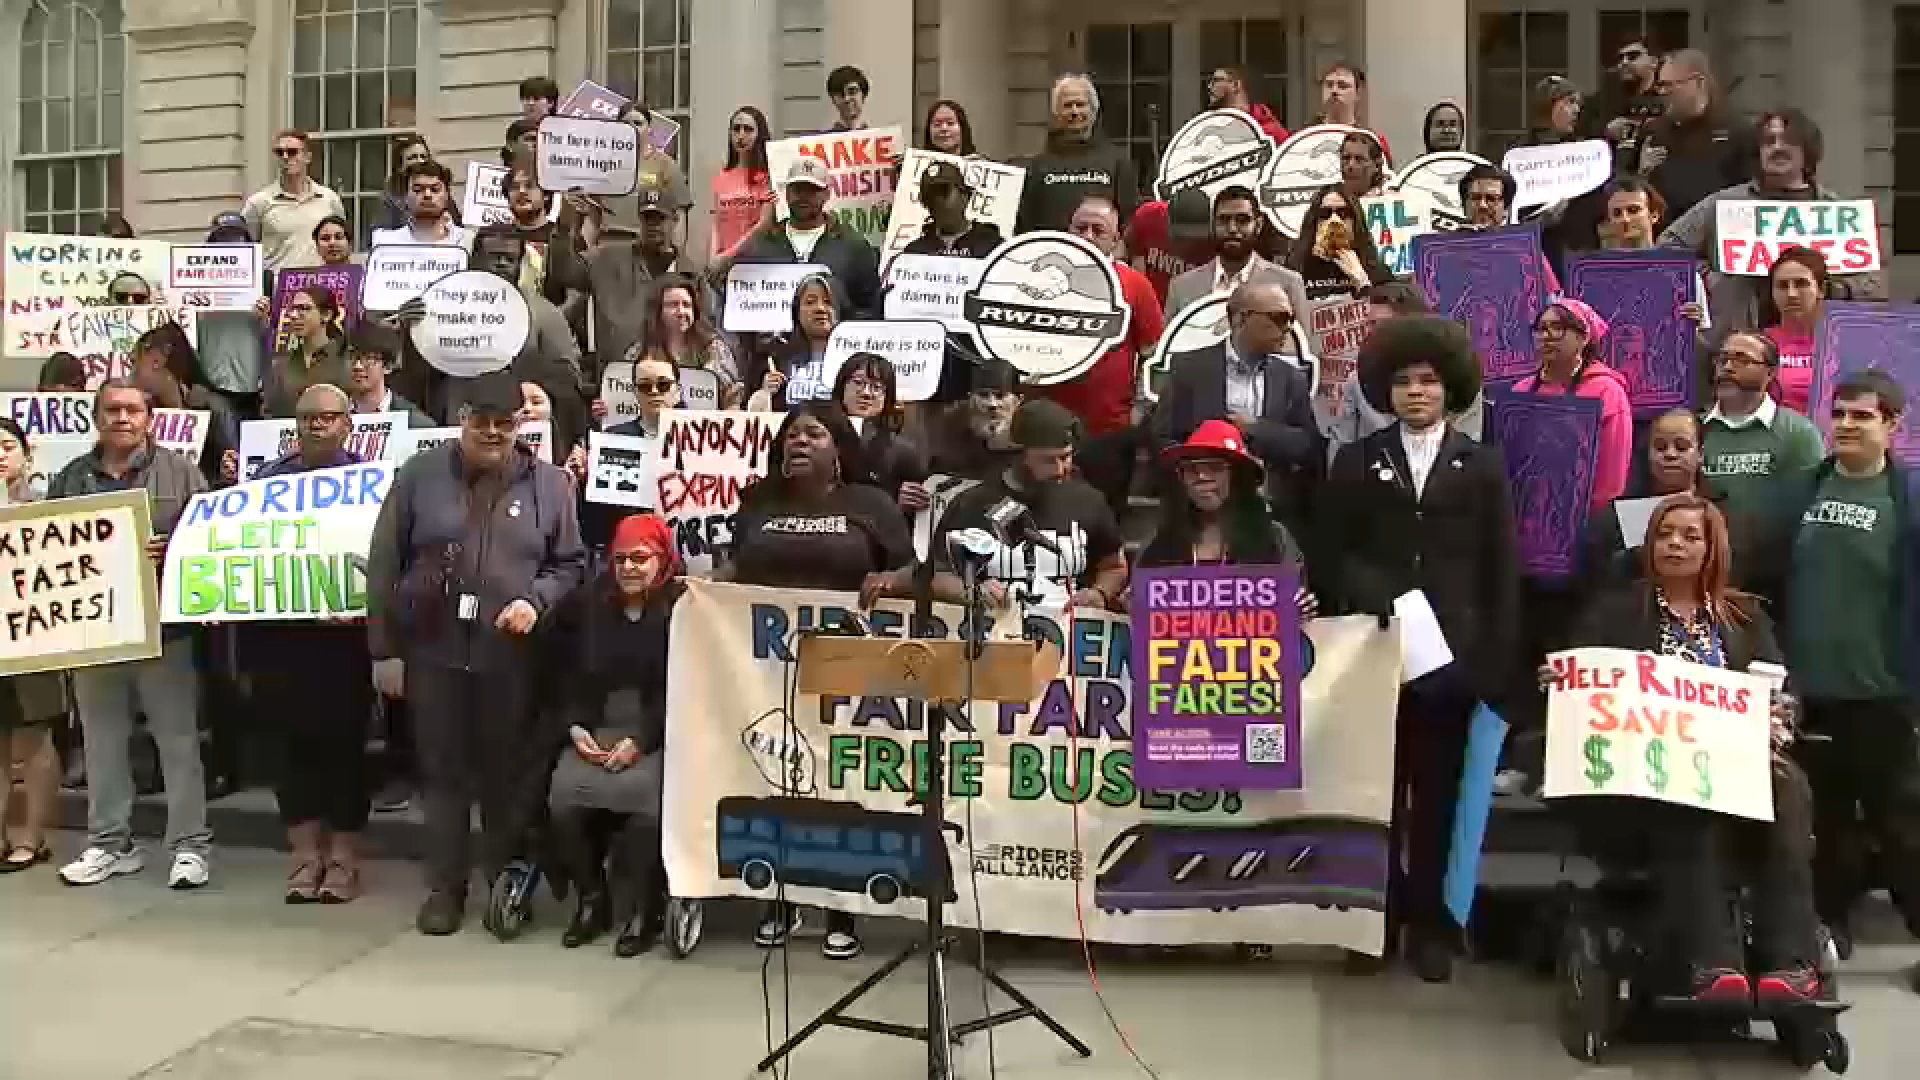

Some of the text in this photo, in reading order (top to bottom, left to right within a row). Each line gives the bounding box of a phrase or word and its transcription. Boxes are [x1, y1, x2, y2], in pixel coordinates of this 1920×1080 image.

[543, 131, 635, 151] The fare is too
[548, 152, 623, 172] damn high!
[829, 169, 897, 199] ANSIT
[1755, 205, 1860, 237] FAIR
[11, 242, 145, 265] WORKING
[187, 254, 239, 266] EXPAND
[733, 279, 757, 291] The
[761, 279, 785, 291] fare
[894, 268, 970, 285] The fare is
[11, 295, 65, 315] NEW
[182, 290, 213, 307] CSS
[433, 288, 469, 305] They
[471, 290, 499, 304] say
[901, 289, 941, 305] damn
[481, 311, 506, 326] too
[977, 304, 1111, 331] RWDSU
[835, 337, 941, 353] The fare is too
[689, 386, 715, 401] too
[7, 396, 91, 435] FARES
[660, 416, 746, 470] MAYOR
[187, 466, 386, 526] NO RIDER
[208, 515, 318, 552] LEFT
[12, 553, 104, 601] FAIR
[1148, 577, 1278, 608] RIDERS
[7, 586, 115, 641] FARES!
[1148, 609, 1279, 637] DEMAND
[1148, 639, 1282, 681] FAIR
[1550, 654, 1751, 714] HELP RIDERS
[997, 680, 1135, 740] FAR
[1148, 682, 1283, 715] FARES!
[1587, 693, 1698, 743] SAVE
[1583, 734, 1615, 790] $
[1644, 738, 1669, 793] $
[1001, 844, 1083, 865] RIDERS
[972, 859, 1084, 881] ALLIANCE
